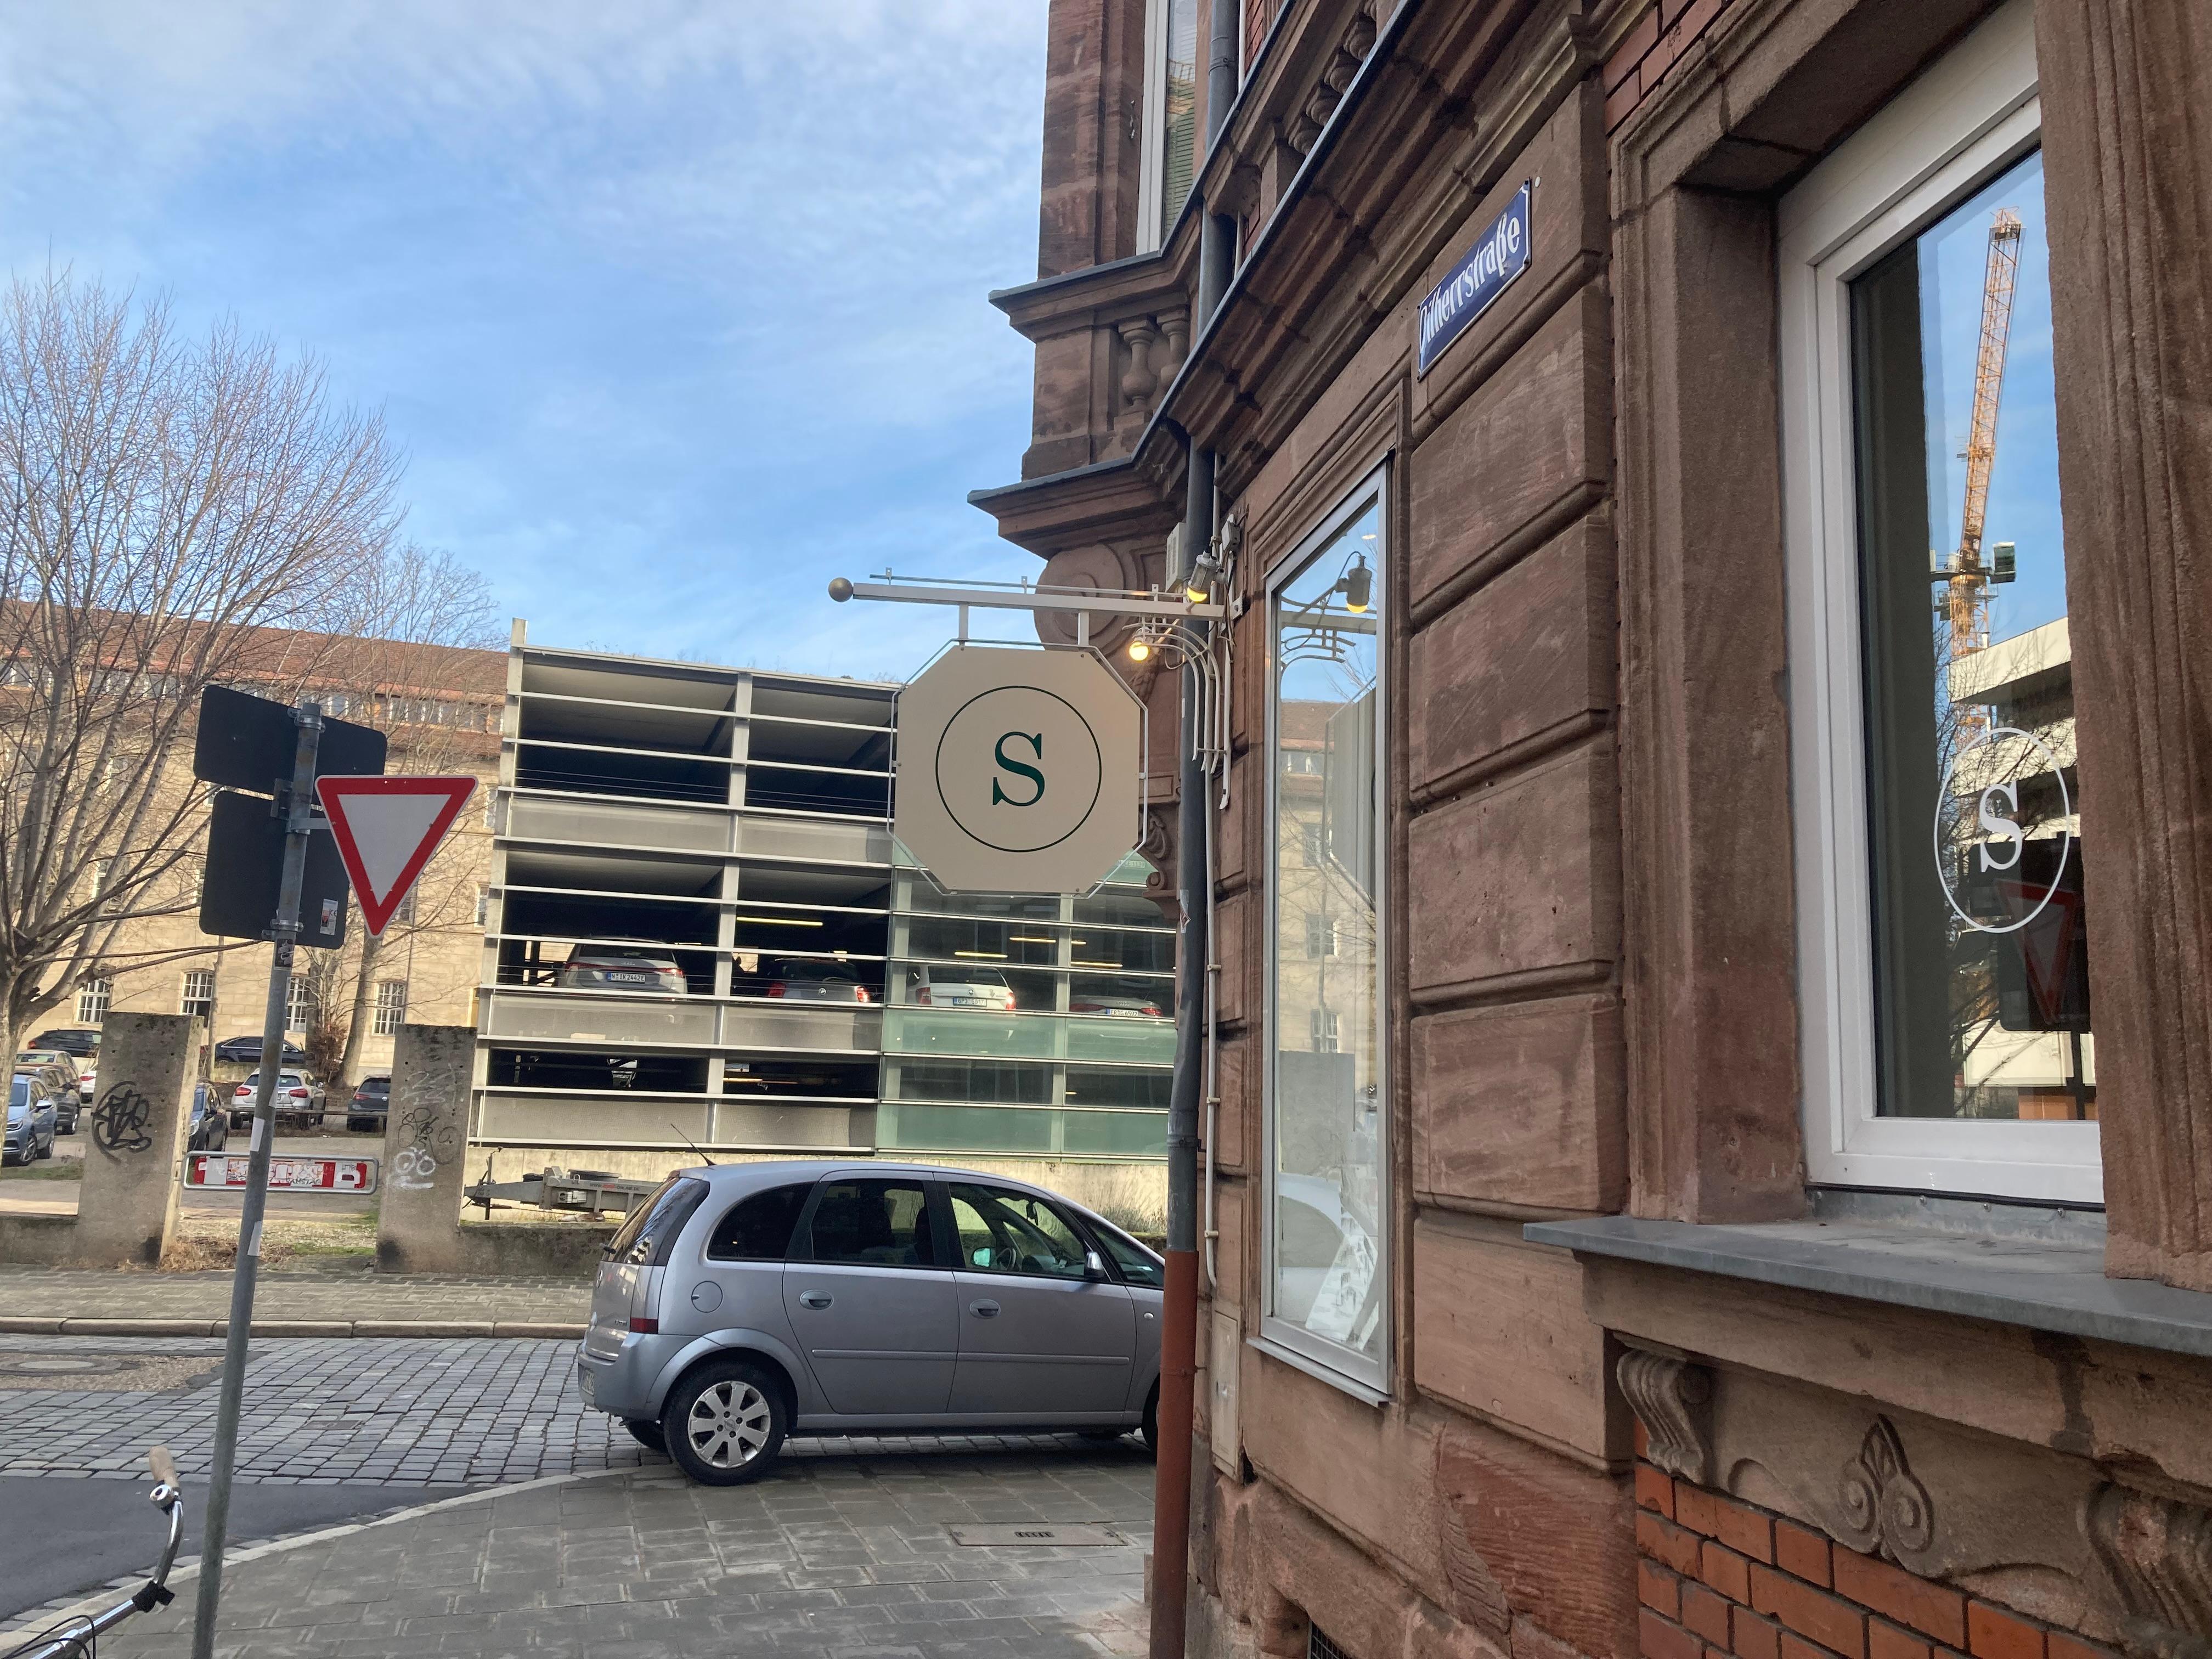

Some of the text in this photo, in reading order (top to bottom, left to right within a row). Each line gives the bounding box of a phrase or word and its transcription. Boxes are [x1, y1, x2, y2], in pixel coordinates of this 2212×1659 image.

[1420, 212, 1520, 352] Dilherrstraße
[992, 731, 1045, 806] S
[1979, 781, 2023, 873] S
